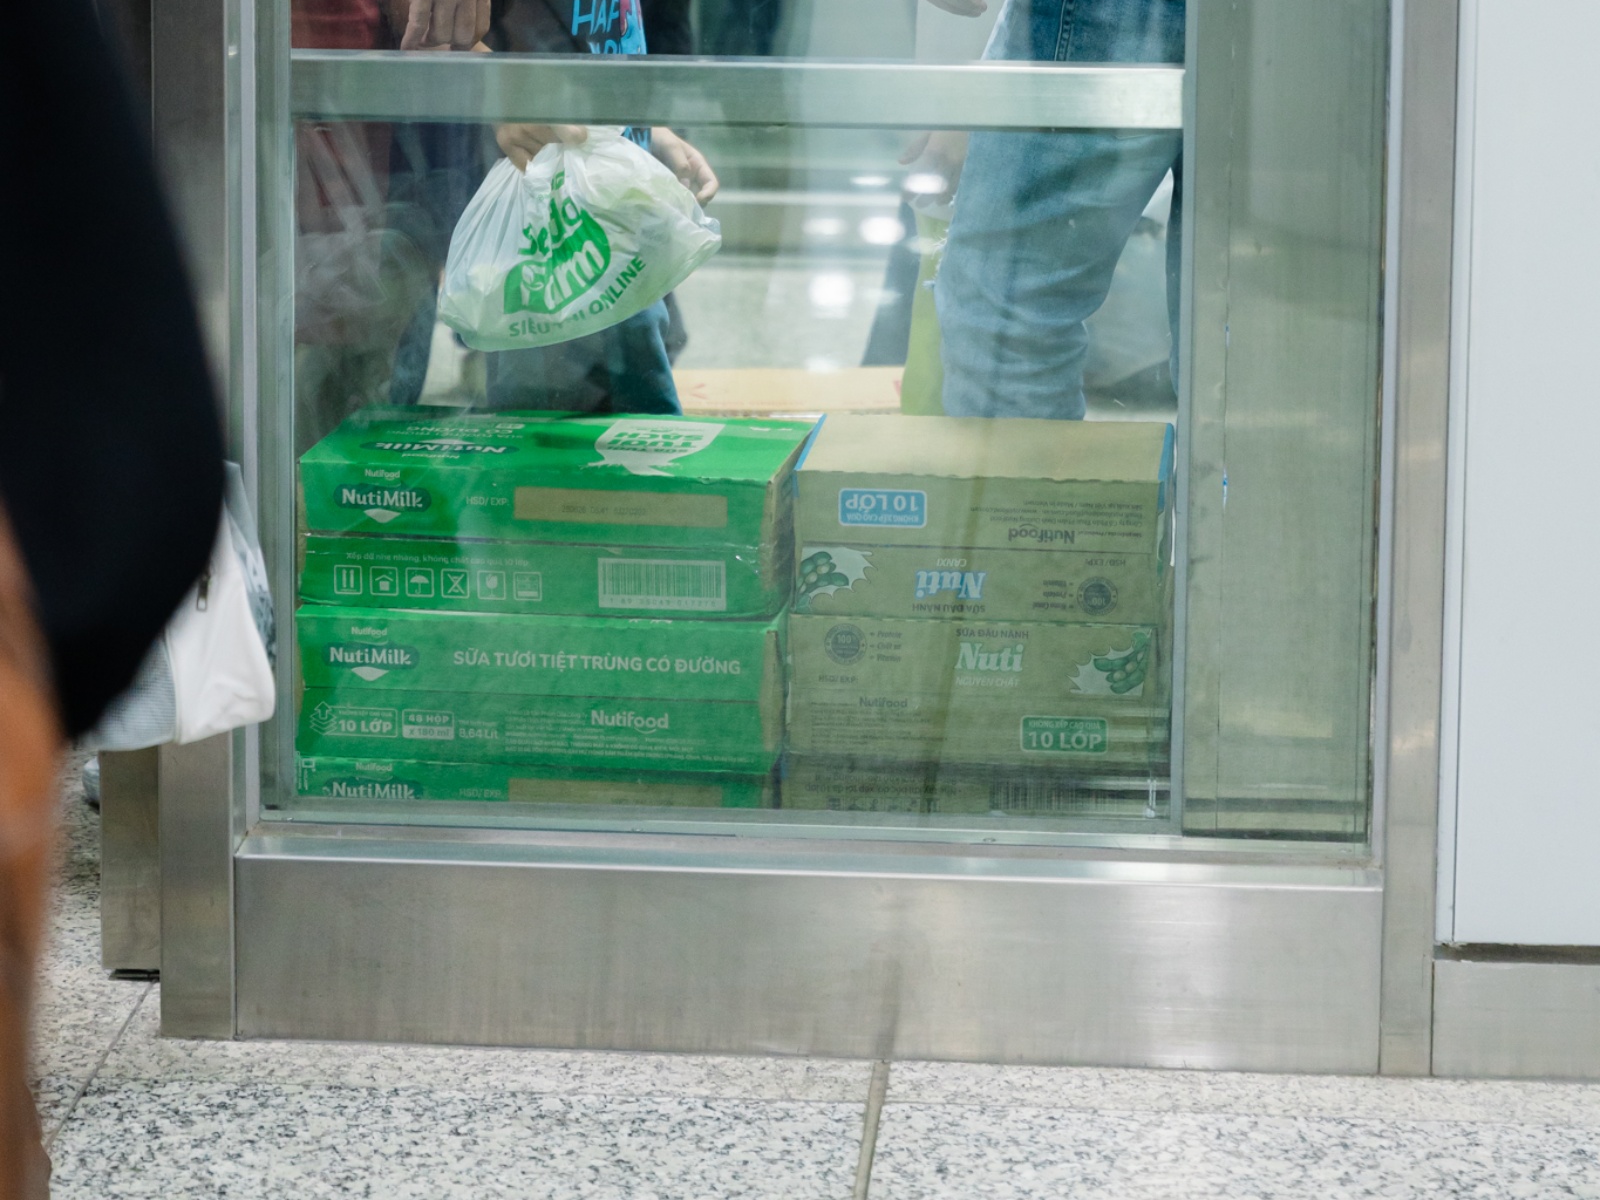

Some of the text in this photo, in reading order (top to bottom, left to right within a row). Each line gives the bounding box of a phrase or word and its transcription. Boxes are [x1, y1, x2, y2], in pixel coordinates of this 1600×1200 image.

[589, 255, 646, 316] ONLINE
[341, 488, 423, 508] NutiMilk
[845, 494, 918, 512] 10 LỚP
[1008, 525, 1075, 544] Nutifood
[916, 571, 987, 599] Nuti
[351, 626, 387, 637] Nutifood
[329, 647, 411, 665] NutiMilk
[454, 647, 741, 674] SỮA TƯƠI TIỆT TRÙNG CÓ ĐƯỜNG
[954, 641, 1024, 672] Nuti
[860, 697, 908, 708] Nutifood
[338, 718, 392, 733] 10 LỚP
[409, 714, 423, 723] 48
[591, 710, 669, 730] Nutifood
[417, 727, 435, 737] 180
[1028, 730, 1101, 749] 10 LỚP
[332, 782, 415, 799] NutiMilk
